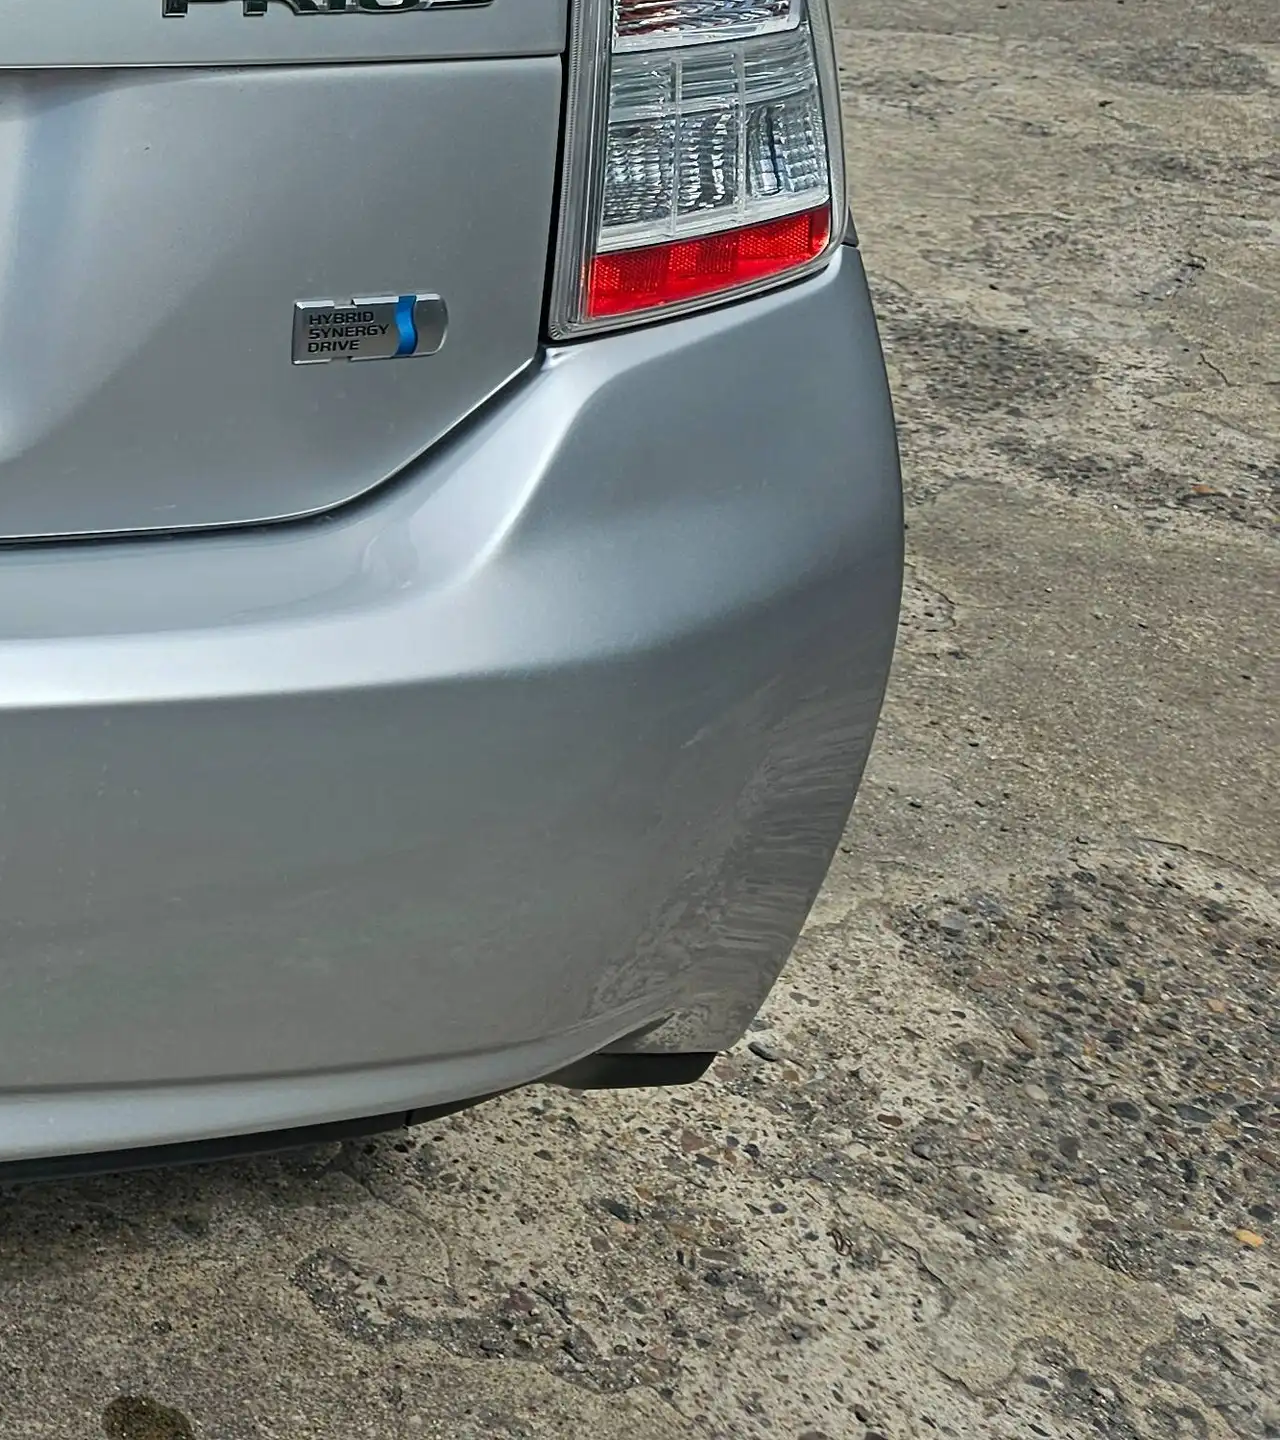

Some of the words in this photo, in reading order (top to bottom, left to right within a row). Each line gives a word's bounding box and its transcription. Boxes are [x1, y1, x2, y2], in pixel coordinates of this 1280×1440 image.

[308, 311, 375, 327] HYBRID
[307, 324, 390, 340] SYNERGY
[307, 339, 361, 354] DRIVE
